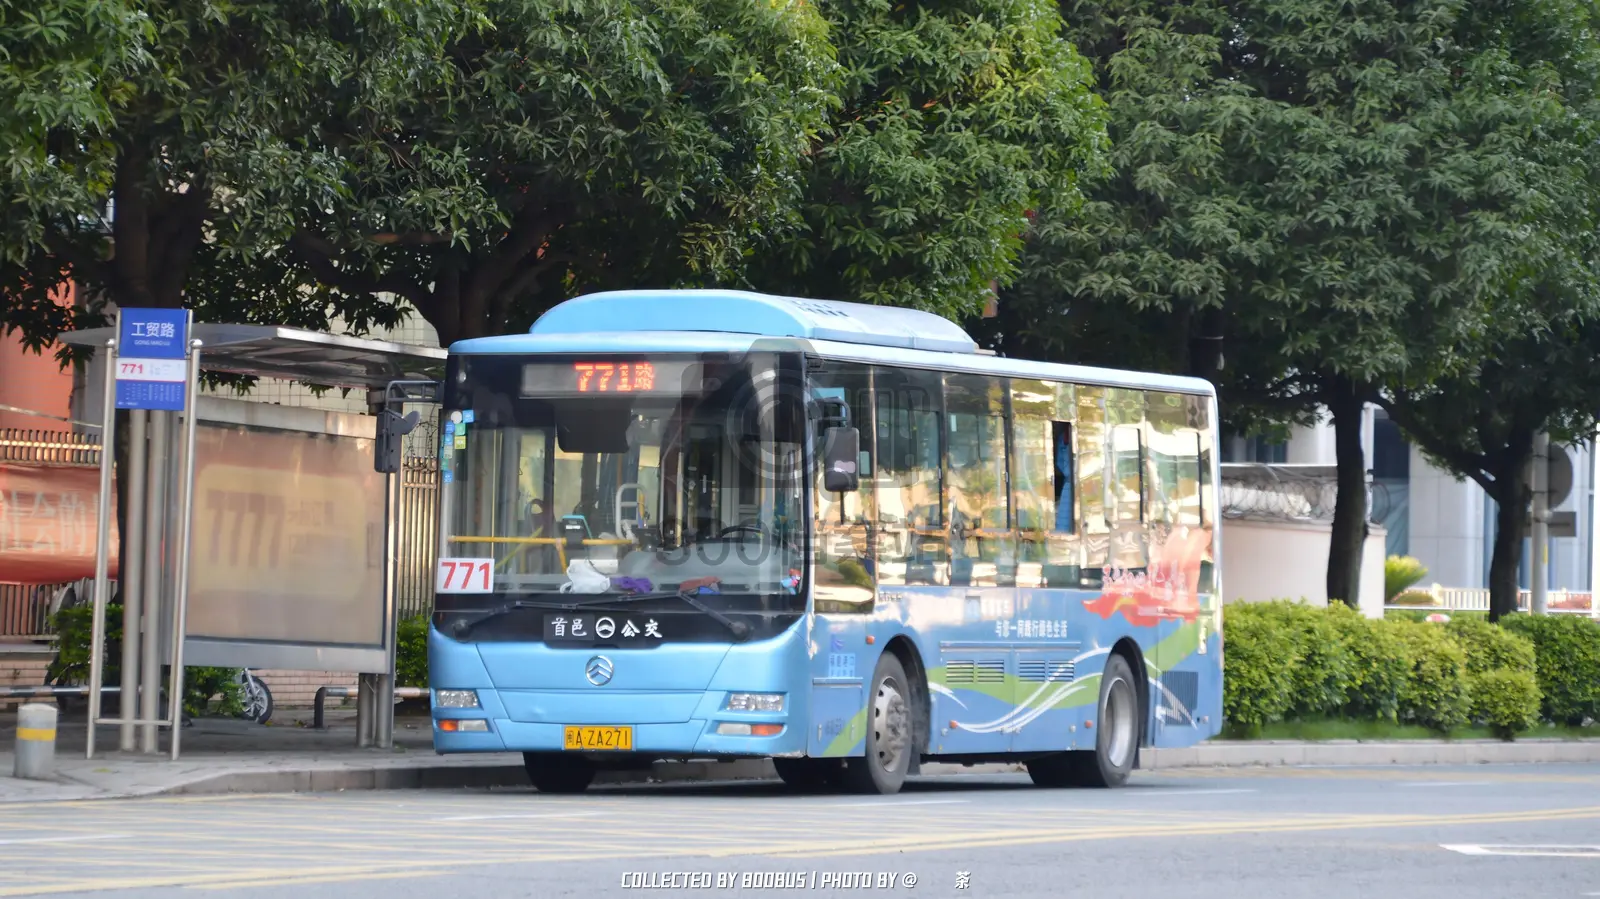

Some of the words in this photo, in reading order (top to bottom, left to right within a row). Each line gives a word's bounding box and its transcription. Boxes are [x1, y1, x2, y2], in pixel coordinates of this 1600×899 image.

[131, 322, 174, 338] 工贸路
[121, 364, 143, 374] 771
[441, 561, 490, 590] 771
[551, 617, 587, 637] 首邑
[621, 618, 663, 638] 公交
